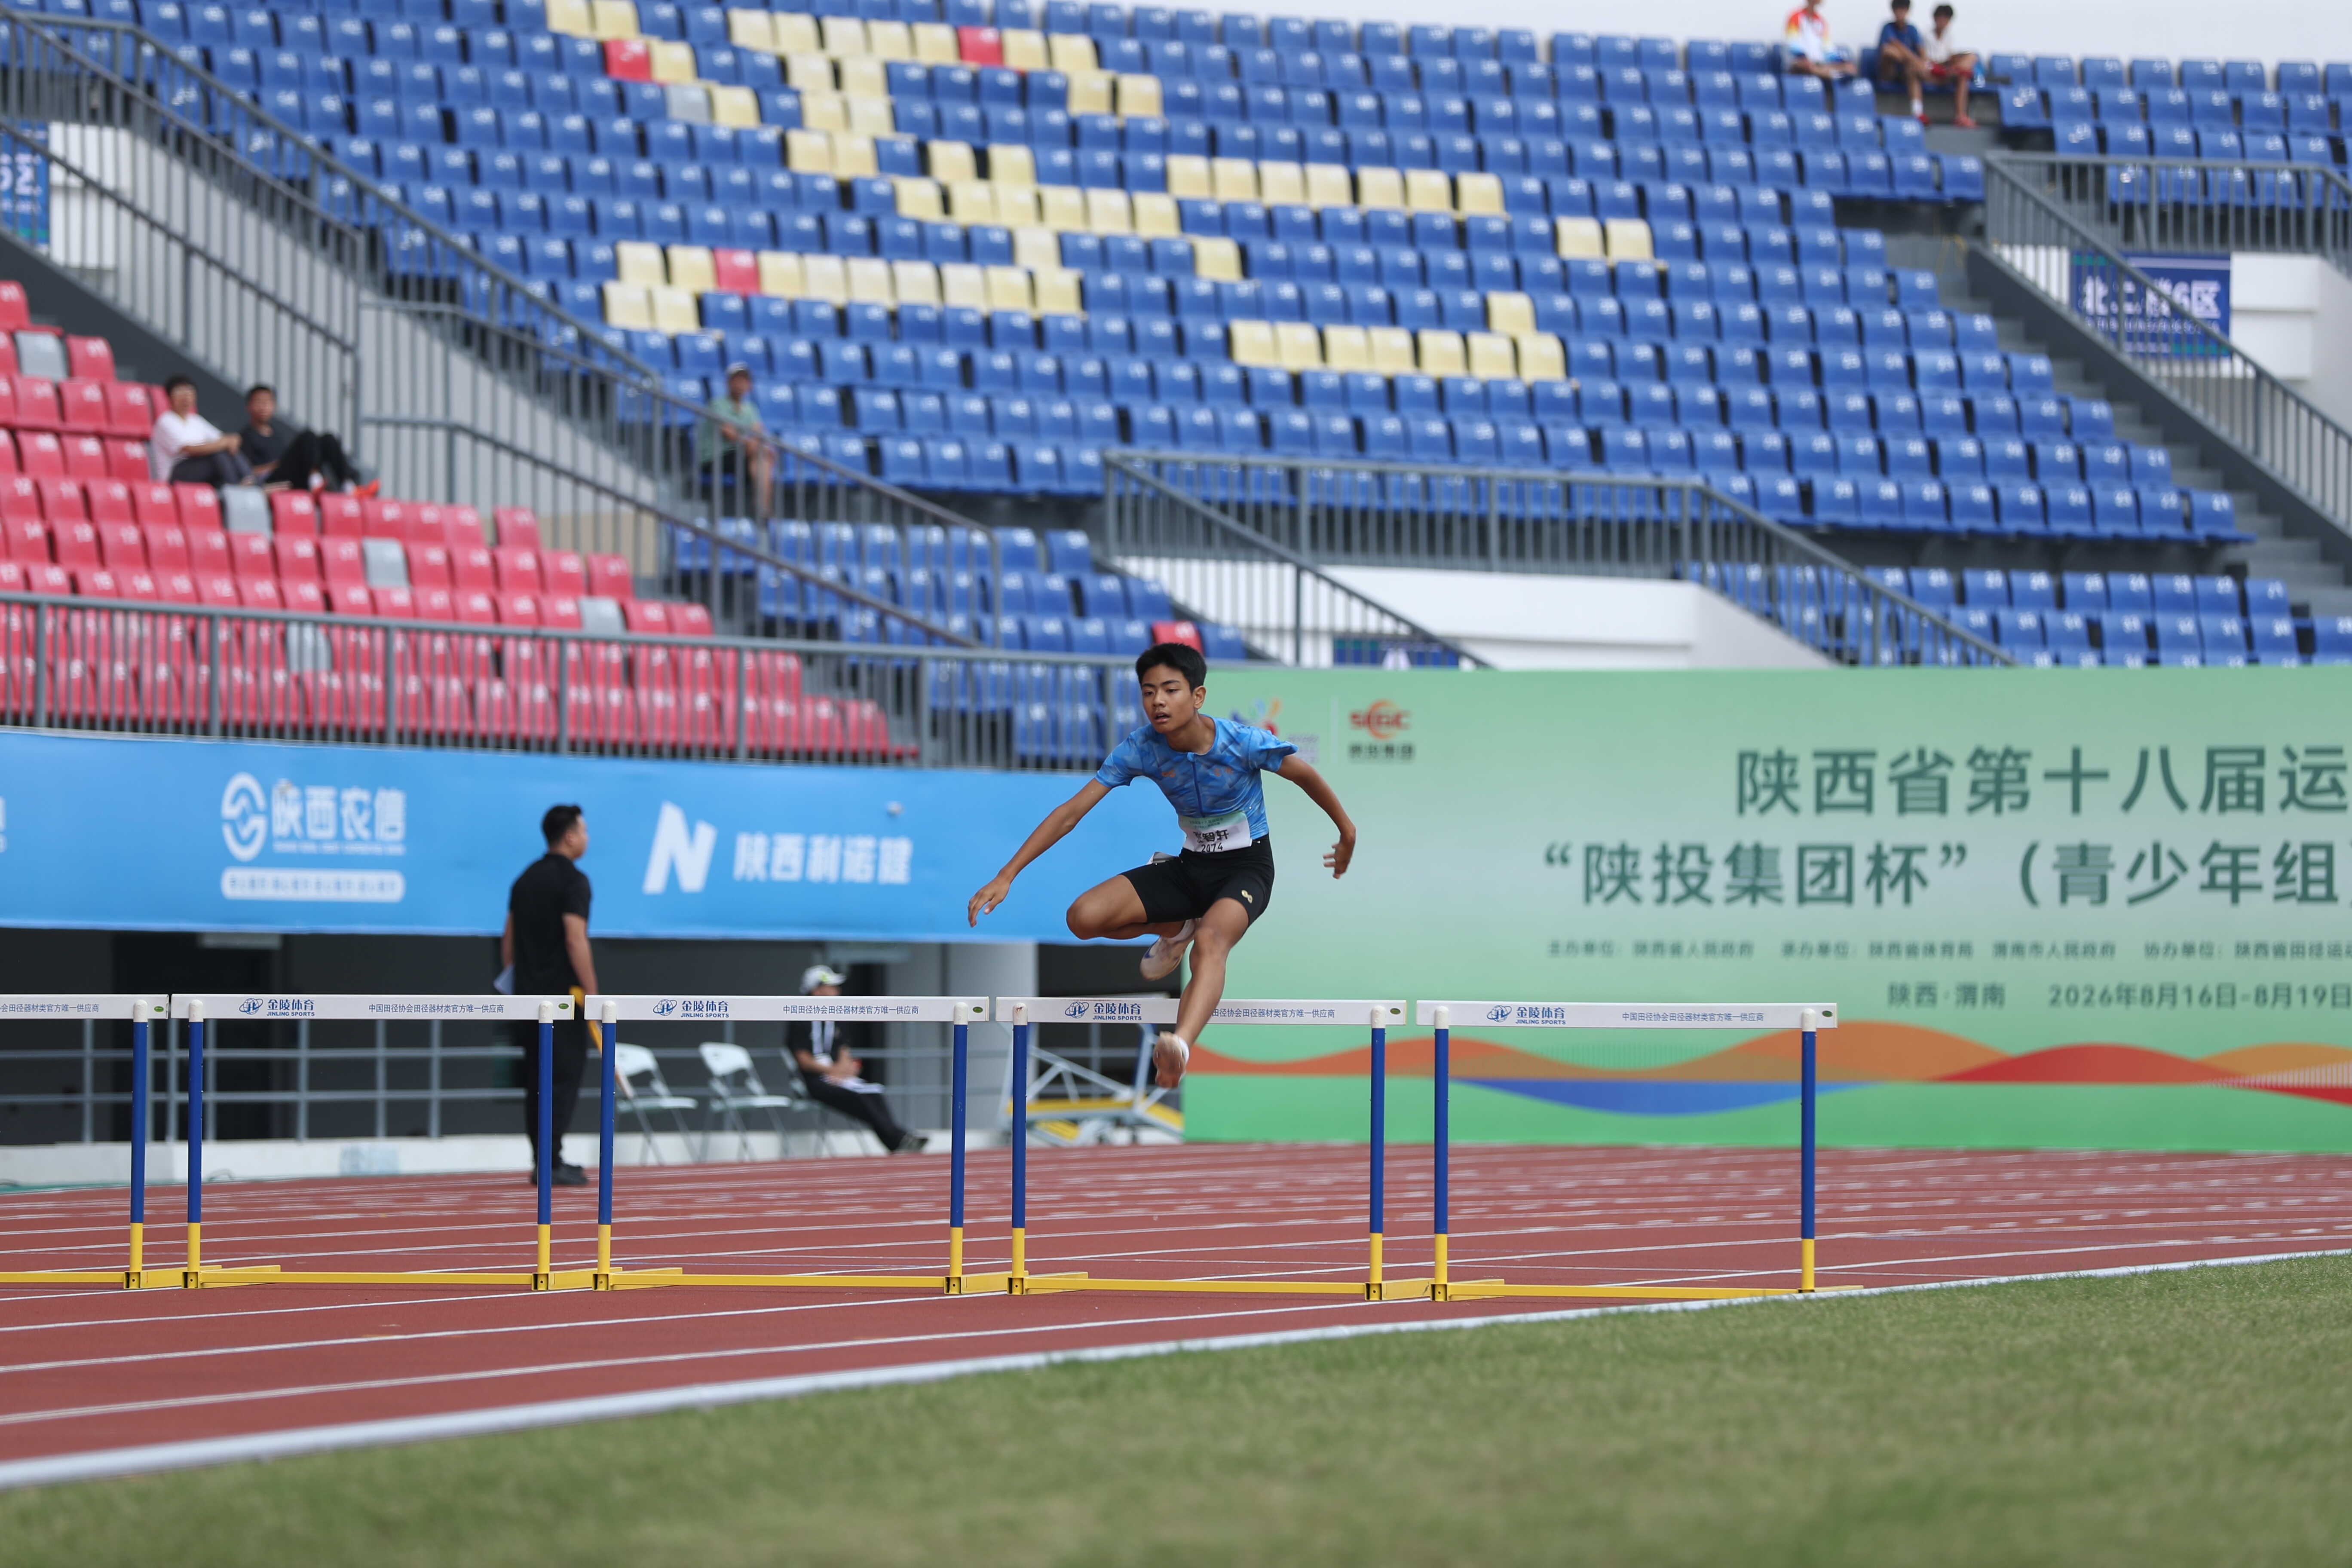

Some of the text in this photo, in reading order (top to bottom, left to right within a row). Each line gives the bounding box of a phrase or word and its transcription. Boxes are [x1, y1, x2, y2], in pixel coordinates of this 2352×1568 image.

[1737, 746, 2349, 816] 陕西省第十八届运
[0, 1004, 100, 1013] 会田径器材类官方唯一供应商
[267, 999, 315, 1010] 金陵体育
[369, 1004, 504, 1013] 中国田径协会田径器材类官方唯一供应商
[681, 1001, 729, 1012] 金陵体育
[783, 1005, 919, 1014] 中国田径协会田径器材类官方唯一供应商
[1093, 1003, 1142, 1015] 金陵体育
[1516, 1007, 1565, 1019] 金陵体育
[1622, 1012, 1764, 1022] 中国田径协会田径器材类官方唯一供应商
